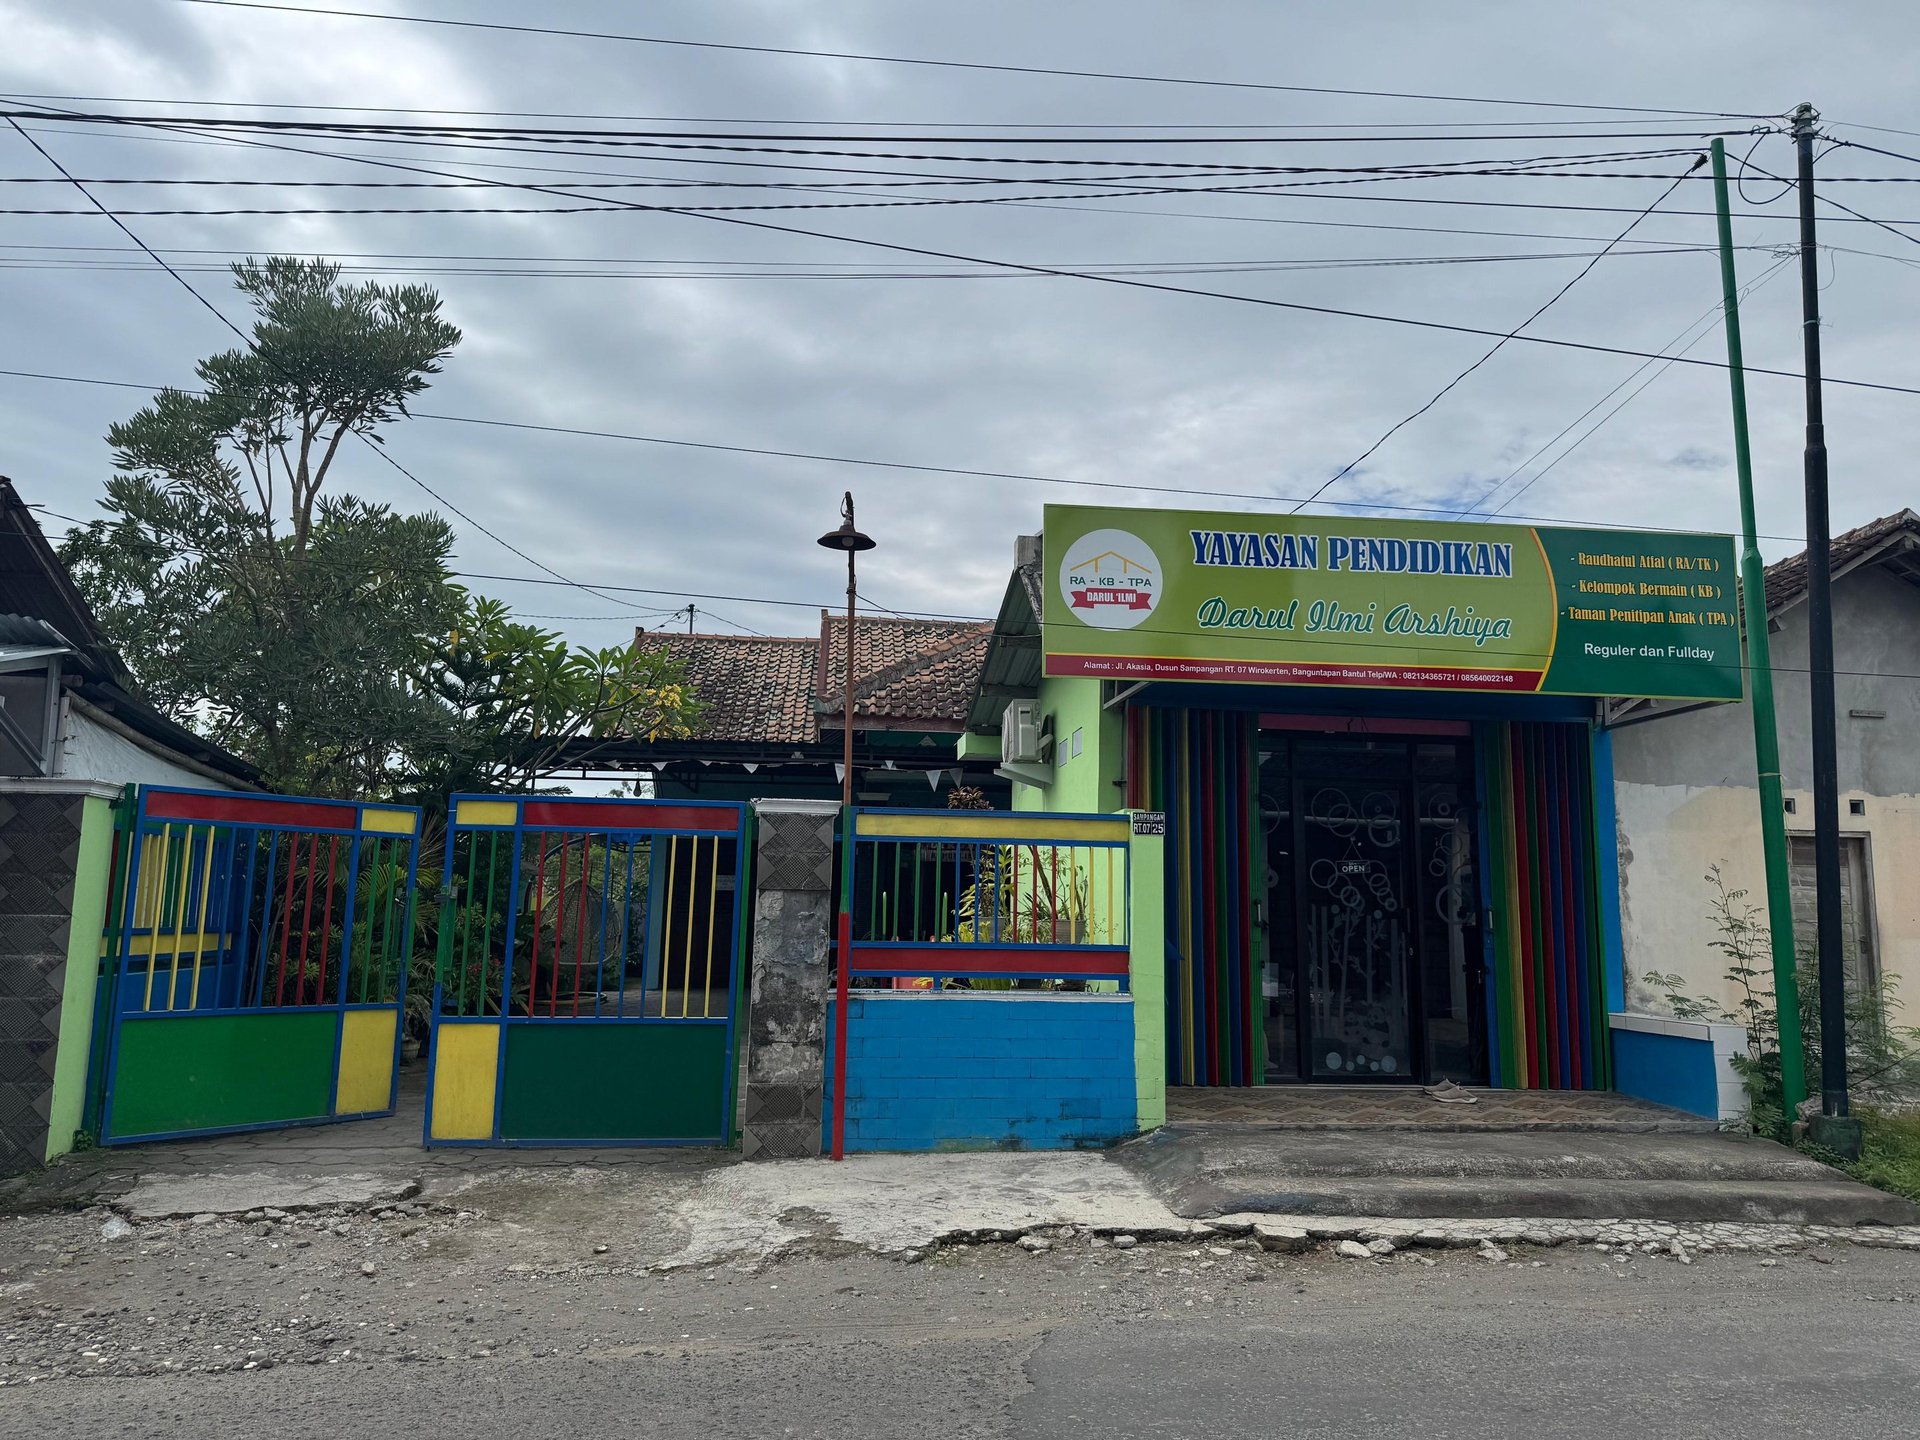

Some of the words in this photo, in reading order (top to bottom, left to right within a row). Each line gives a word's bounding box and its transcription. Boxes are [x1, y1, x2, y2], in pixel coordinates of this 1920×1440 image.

[1190, 530, 1319, 570] YAYASAN
[1327, 536, 1513, 578] PENDIDIKAN
[1578, 552, 1636, 568] Raudhatul
[1069, 576, 1086, 585] RA
[1099, 577, 1115, 586] KB
[1128, 577, 1152, 587] TPA
[1579, 579, 1636, 596] Kelompok
[1639, 582, 1688, 597] Bermain
[1086, 591, 1115, 602] DARUL
[1198, 596, 1299, 630] Darul
[1304, 600, 1377, 633] Ilmi
[1383, 602, 1512, 647] Arshiya
[1568, 606, 1606, 621] Taman
[1609, 608, 1664, 624] Penitipan
[1668, 611, 1696, 625] Anak
[1584, 642, 1636, 658] Reguler
[1639, 645, 1664, 657] dan
[1668, 646, 1715, 662] Fullday
[1083, 661, 1110, 669] Alamat
[1126, 663, 1154, 671] Akasia,
[1180, 664, 1223, 674] Sampangan
[1248, 666, 1291, 675] Wirokerten,
[1292, 668, 1341, 677] Banguntapan
[1342, 670, 1367, 678] Bantul
[1402, 672, 1455, 681] 082134365721
[1460, 673, 1514, 682] 085640022148
[1152, 823, 1163, 833] 25
[1341, 865, 1365, 873] OPEN
